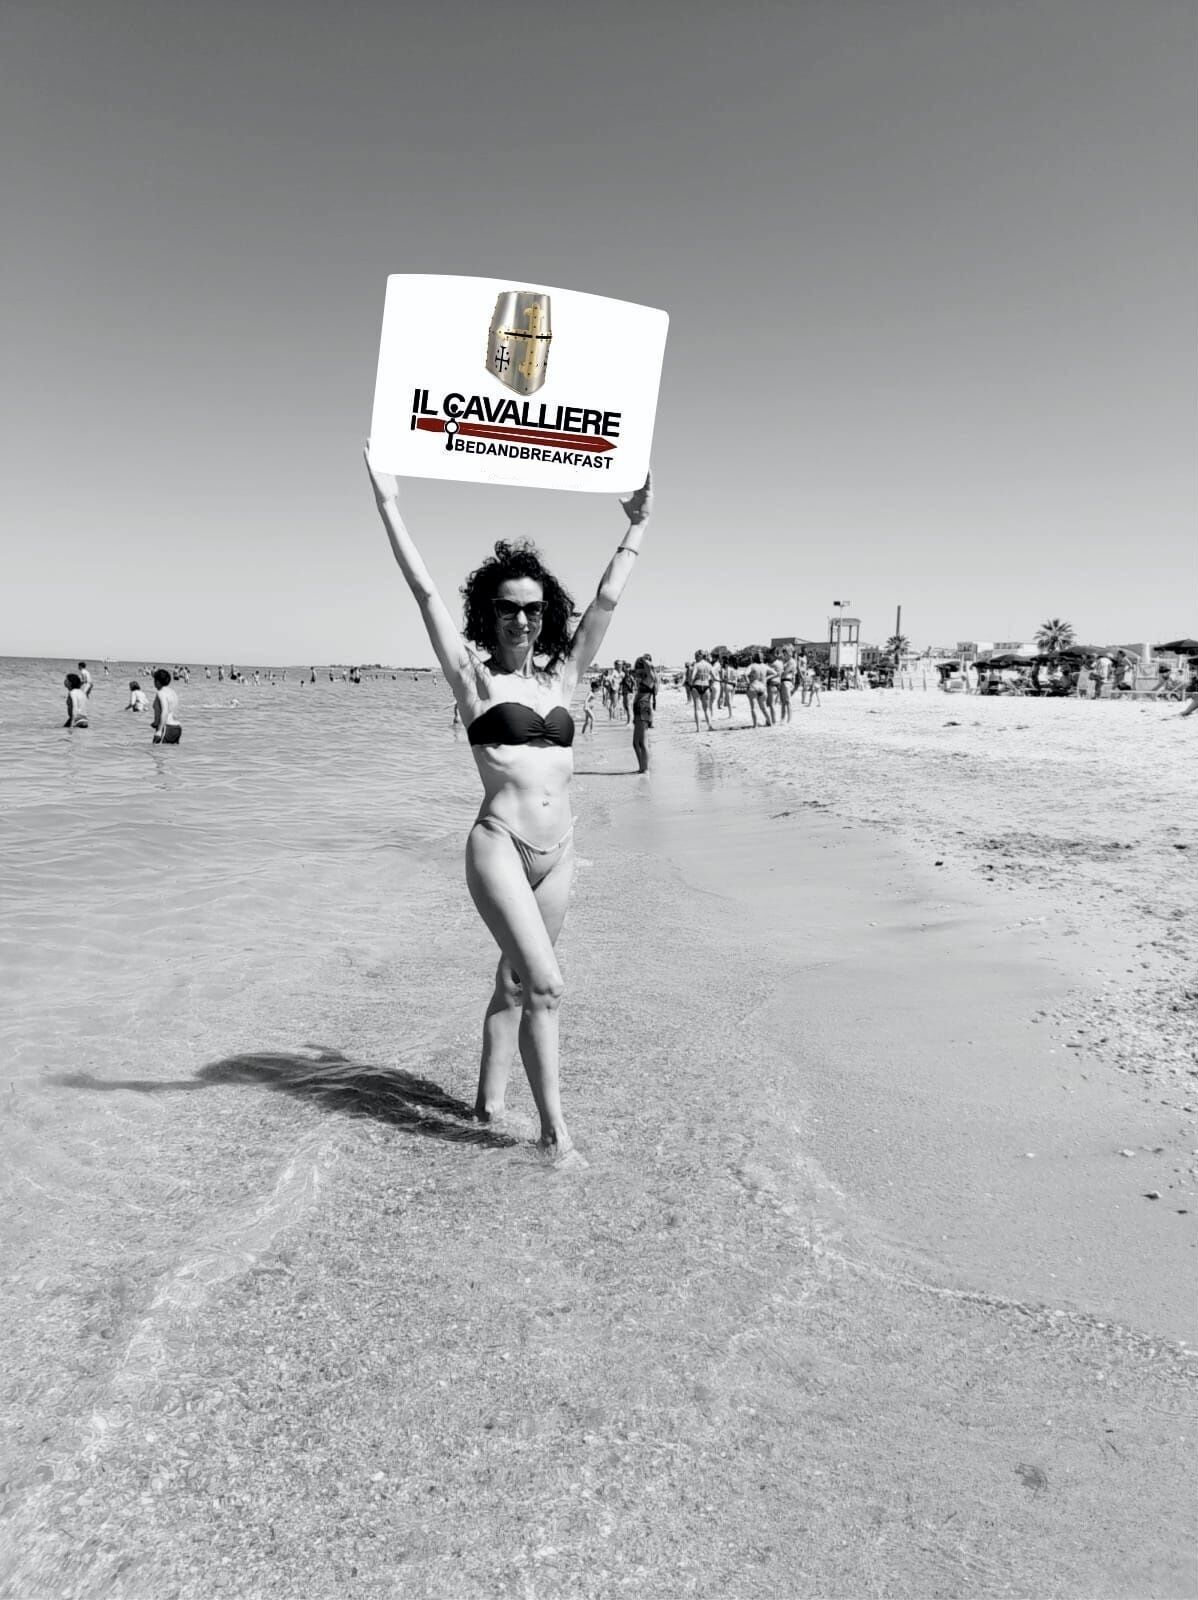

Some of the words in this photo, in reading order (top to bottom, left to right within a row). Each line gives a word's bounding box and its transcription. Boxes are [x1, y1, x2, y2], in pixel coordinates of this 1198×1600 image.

[412, 388, 438, 415] IL
[443, 392, 621, 437] CAVALLIERE
[454, 438, 613, 469] BEDANDBREAKFAST
